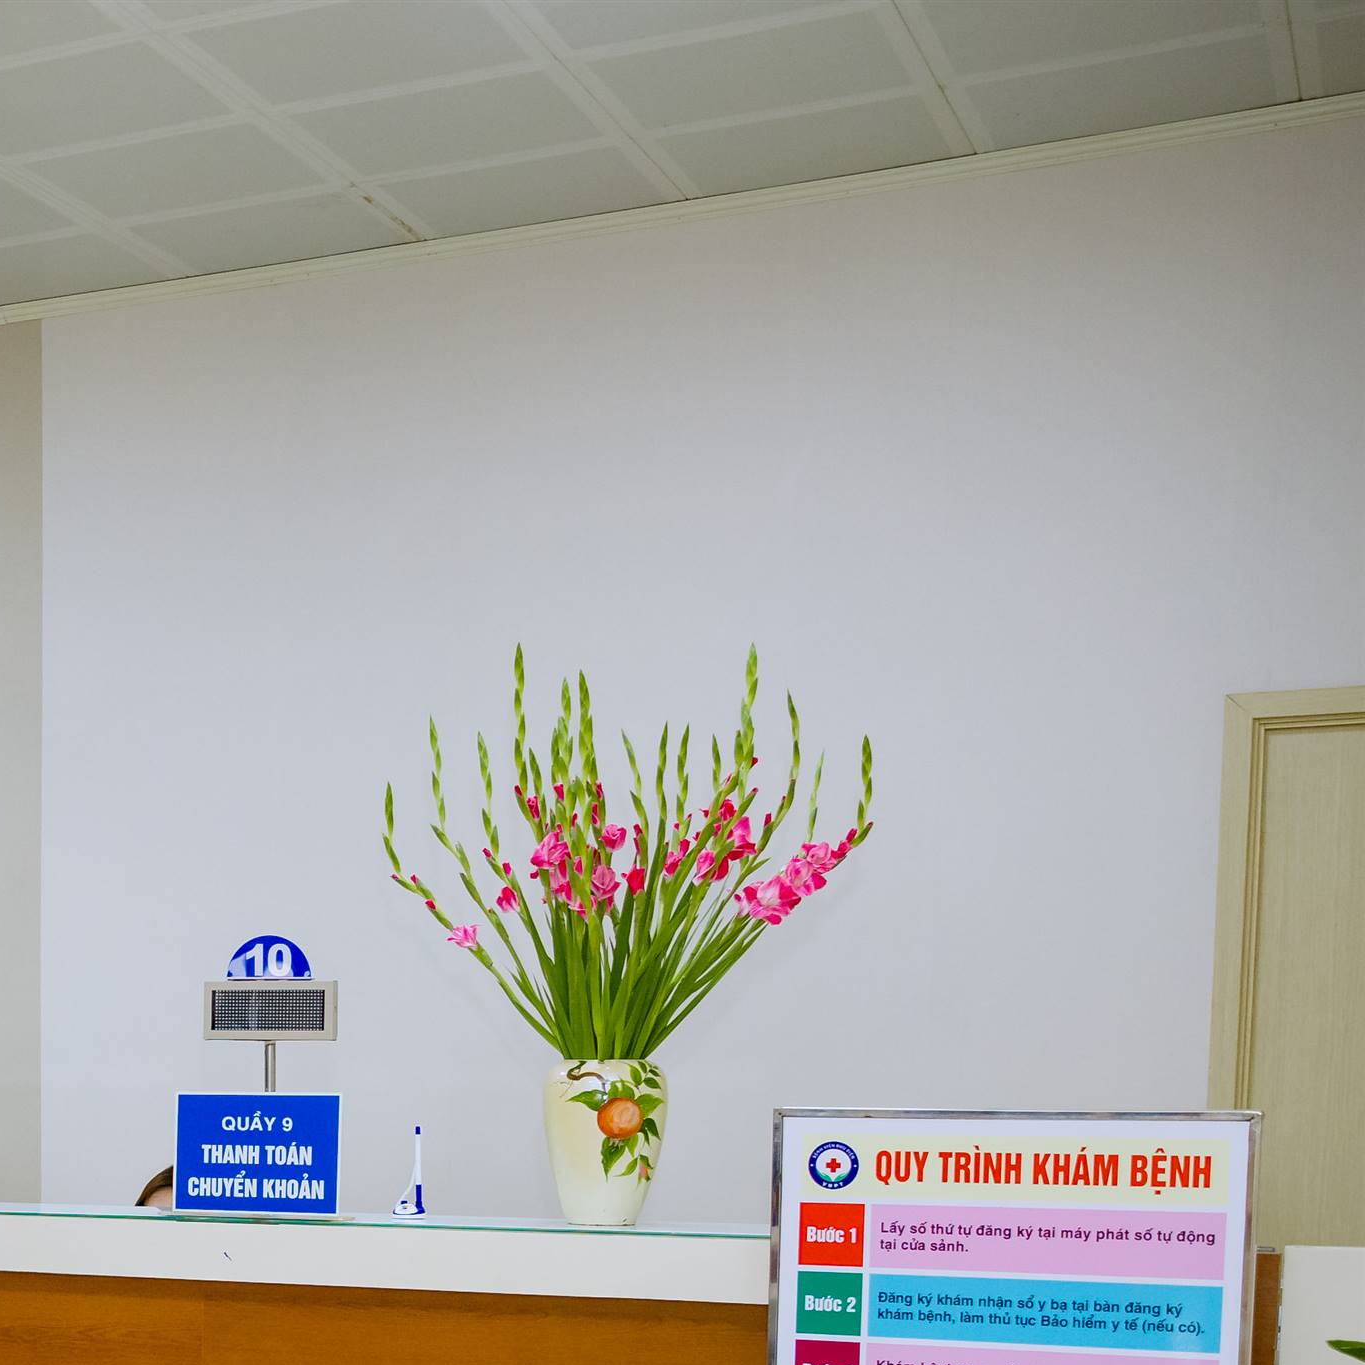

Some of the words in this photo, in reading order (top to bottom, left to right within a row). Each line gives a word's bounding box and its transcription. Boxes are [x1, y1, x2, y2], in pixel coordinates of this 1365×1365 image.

[245, 943, 292, 977] 10
[282, 1117, 293, 1132] 9
[201, 1144, 260, 1165] THANH
[265, 1142, 312, 1166] TOÁN
[875, 1150, 928, 1185] QUY
[939, 1145, 1022, 1184] TRÌNH
[1033, 1148, 1119, 1187] KHÁM
[1130, 1149, 1212, 1195] BỆNH
[188, 1170, 257, 1198] CHUYỂN
[262, 1173, 325, 1200] KHOẢN
[806, 1226, 845, 1244] Bước
[849, 1227, 857, 1243] 1
[880, 1238, 896, 1252] tại
[901, 1238, 925, 1250] cửa
[930, 1241, 968, 1252] sảnh.
[881, 1221, 905, 1236] Lấy
[910, 1222, 927, 1234] số
[931, 1224, 955, 1235] thứ
[957, 1225, 973, 1238] tự
[976, 1225, 1011, 1240] đăng
[1017, 1226, 1033, 1240] ký
[1038, 1227, 1055, 1240] tại
[1061, 1227, 1091, 1242] máy
[1096, 1228, 1129, 1242] phát
[1134, 1228, 1152, 1241] số
[1157, 1230, 1173, 1244] tự
[1177, 1230, 1215, 1246] động
[804, 1295, 844, 1312] Bước
[847, 1296, 856, 1313] 2
[878, 1292, 912, 1306] Đăng
[917, 1293, 933, 1307] ký
[937, 1294, 973, 1306] khám
[979, 1296, 1012, 1310] nhận
[1017, 1296, 1034, 1309] sổ
[1038, 1300, 1046, 1312] y
[1051, 1299, 1067, 1312] bạ
[1071, 1300, 1089, 1313] tại
[1094, 1300, 1119, 1312] bàn
[1125, 1302, 1161, 1316] đăng
[1166, 1303, 1183, 1317] ký
[877, 1308, 913, 1320] khám
[918, 1310, 955, 1324] bệnh,
[960, 1312, 984, 1324] làm
[989, 1312, 1011, 1325] thủ
[1015, 1315, 1036, 1328] tục
[1041, 1314, 1068, 1327] Bảo
[1073, 1316, 1107, 1329] hiểm
[1111, 1321, 1120, 1332] y
[1124, 1318, 1137, 1330] tế
[1142, 1319, 1173, 1334] (nếu
[1178, 1321, 1204, 1336] có).
